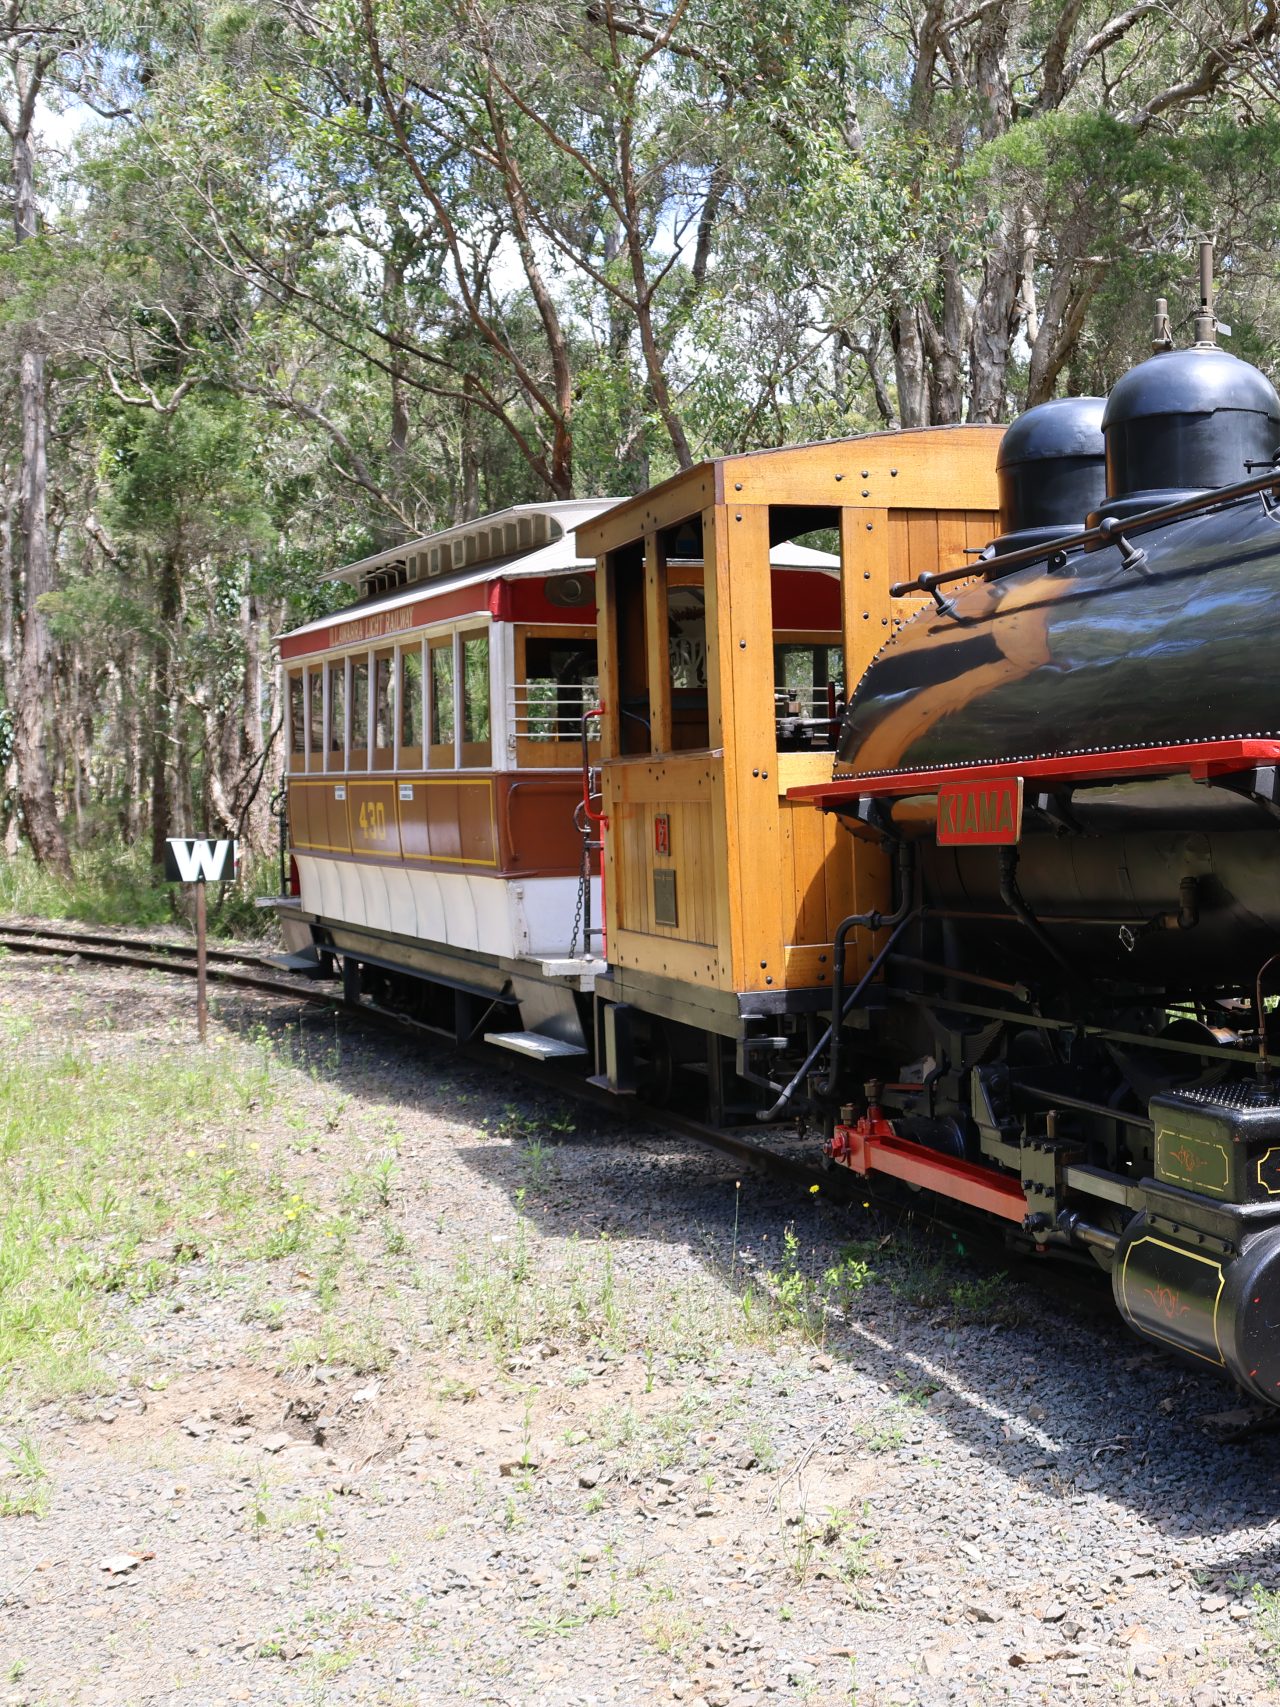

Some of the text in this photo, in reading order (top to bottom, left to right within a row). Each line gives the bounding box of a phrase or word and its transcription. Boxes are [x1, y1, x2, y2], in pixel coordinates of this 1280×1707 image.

[359, 801, 386, 841] 430
[941, 791, 1013, 833] KIAMA
[170, 840, 229, 881] W
